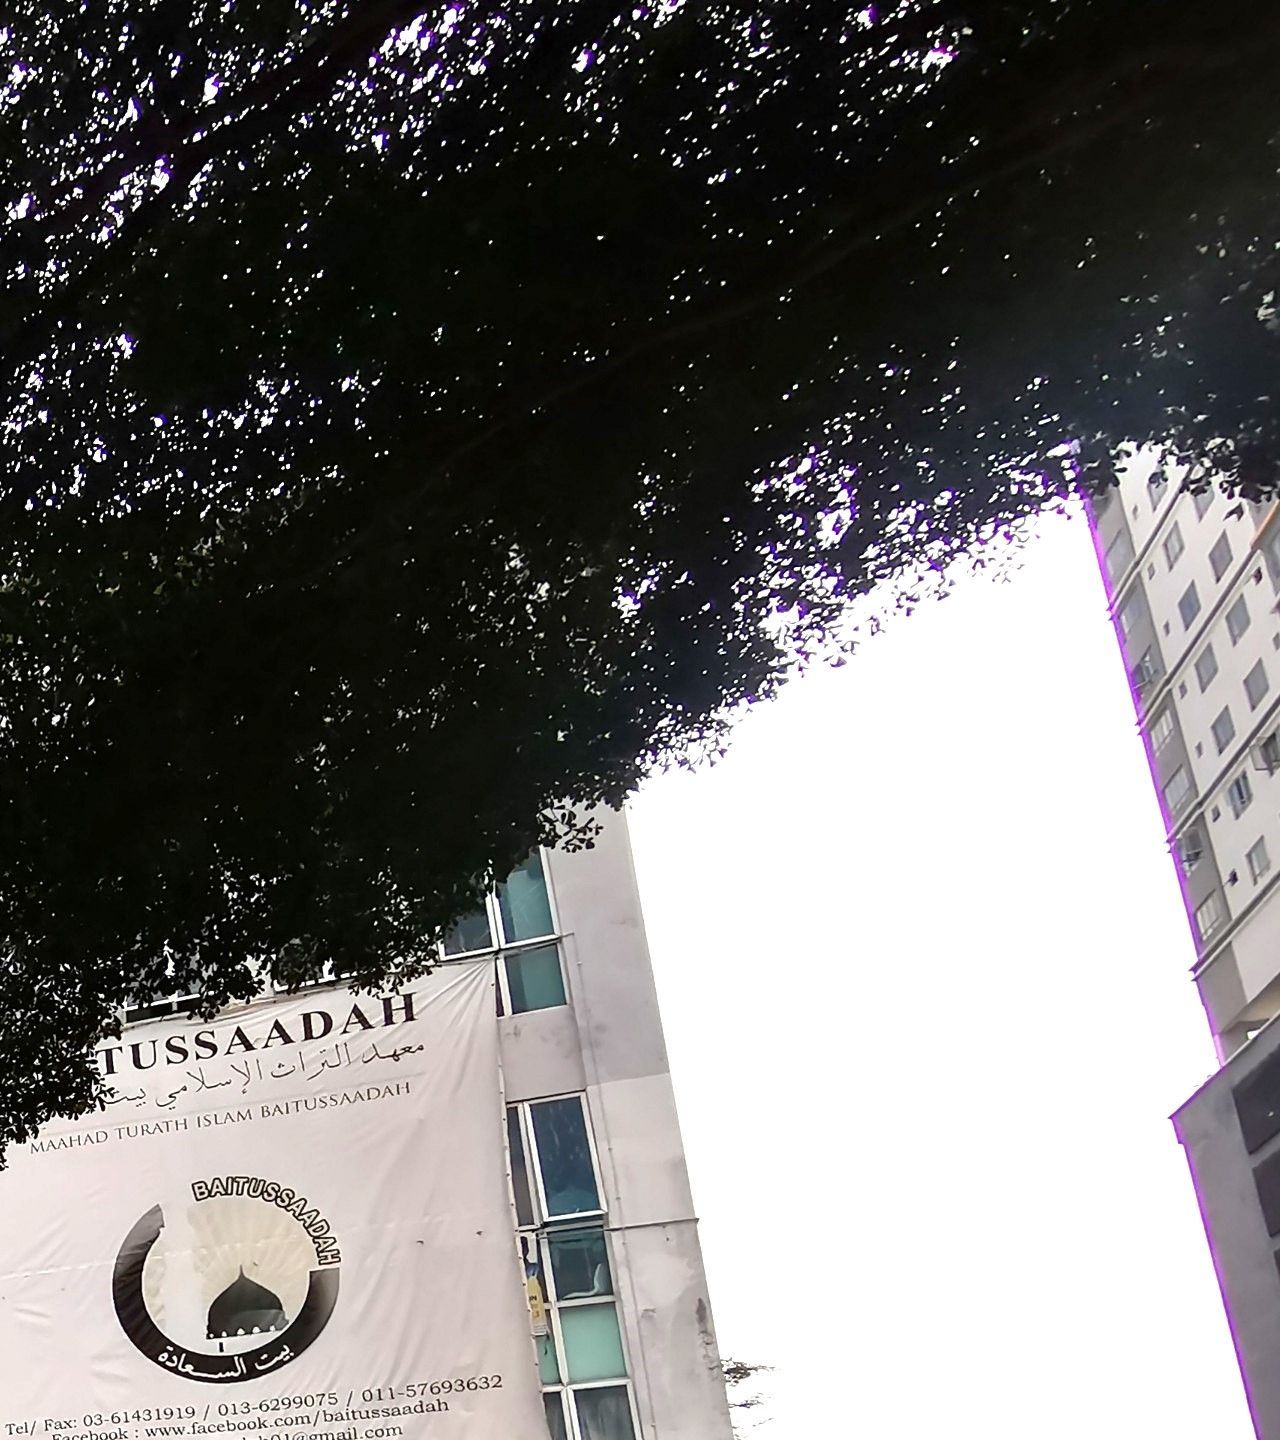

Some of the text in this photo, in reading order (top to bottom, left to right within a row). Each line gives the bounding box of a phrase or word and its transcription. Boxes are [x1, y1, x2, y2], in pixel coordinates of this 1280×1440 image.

[96, 992, 417, 1075] TUSSAADAH
[361, 1042, 425, 1064] معهد
[270, 1042, 352, 1081] التراث
[30, 1082, 411, 1154] MAAHAD TURATH ISLAM BAITUSSAADAH
[192, 1176, 341, 1265] BAITUSSAADAH
[255, 1344, 295, 1372] بيت
[44, 1418, 77, 1432] Fax:
[83, 1406, 195, 1427] 03-61431919
[218, 1392, 338, 1416] 013-6299075
[362, 1375, 503, 1402] 011-57693632
[145, 1399, 449, 1438] www.facebook.com/baitussaadah
